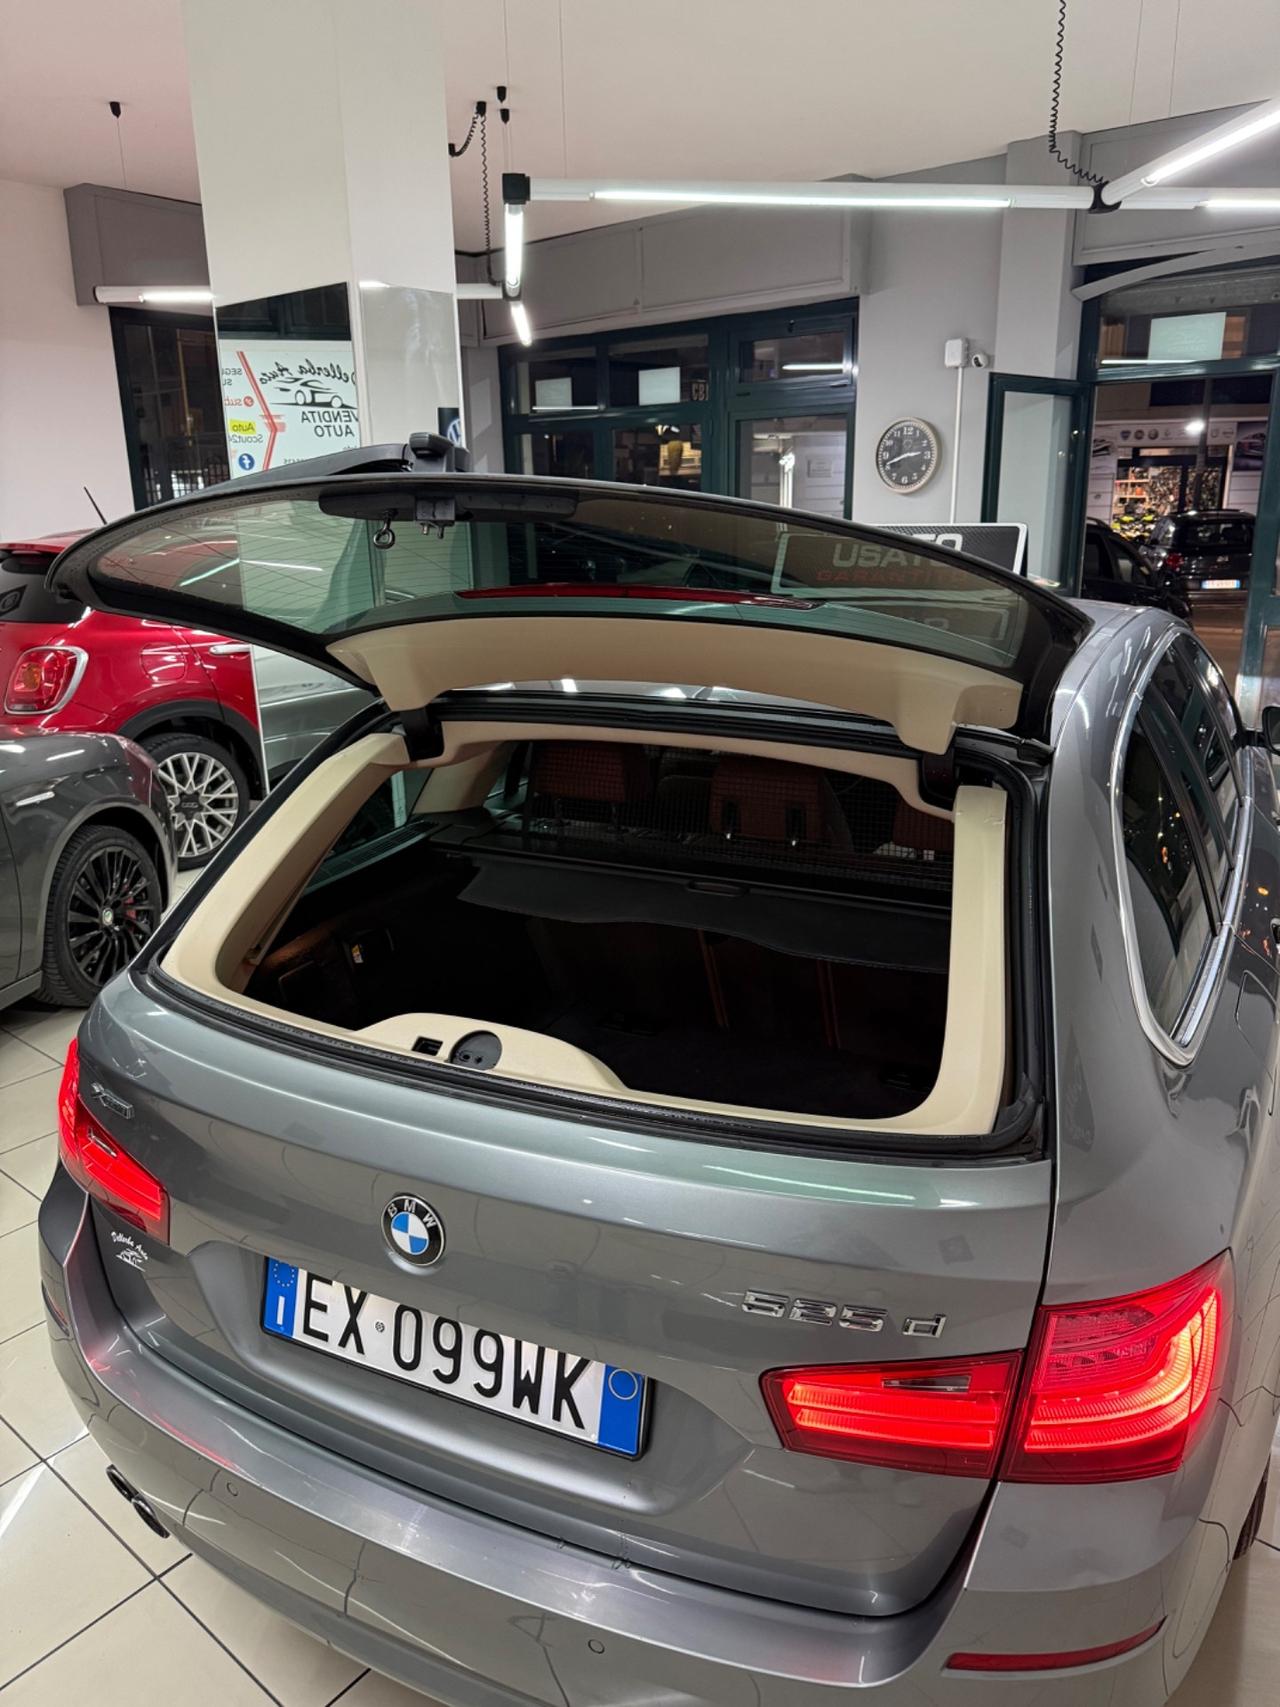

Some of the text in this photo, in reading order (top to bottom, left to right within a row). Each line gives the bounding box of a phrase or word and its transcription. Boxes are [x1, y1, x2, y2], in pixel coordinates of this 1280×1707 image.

[387, 1198, 437, 1229] BMW
[741, 1290, 947, 1339] 525 d
[303, 1272, 592, 1430] EX 099WK
